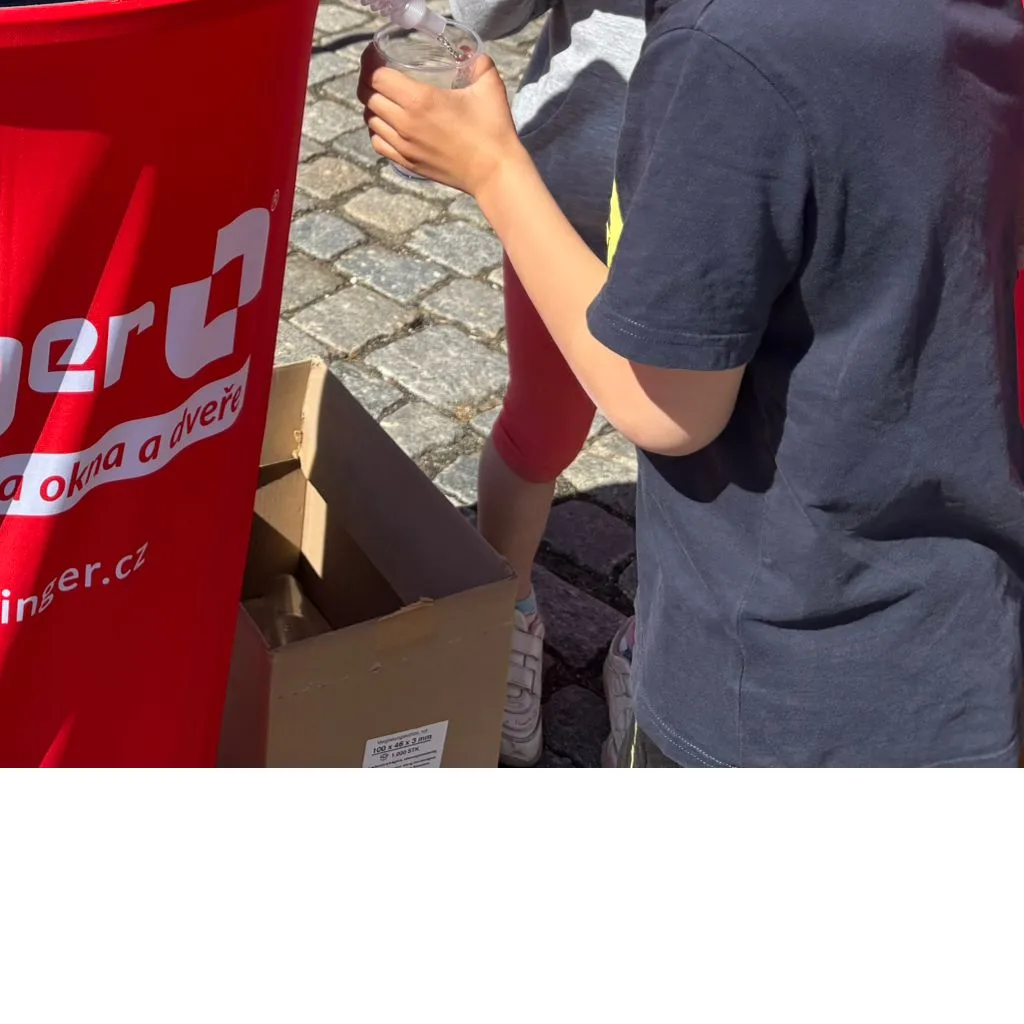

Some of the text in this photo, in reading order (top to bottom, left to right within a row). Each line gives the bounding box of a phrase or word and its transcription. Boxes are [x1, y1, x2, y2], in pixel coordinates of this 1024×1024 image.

[39, 441, 126, 503] okna
[138, 434, 162, 464] a
[169, 383, 243, 449] dveře
[372, 745, 386, 754] 100
[418, 734, 432, 742] mm
